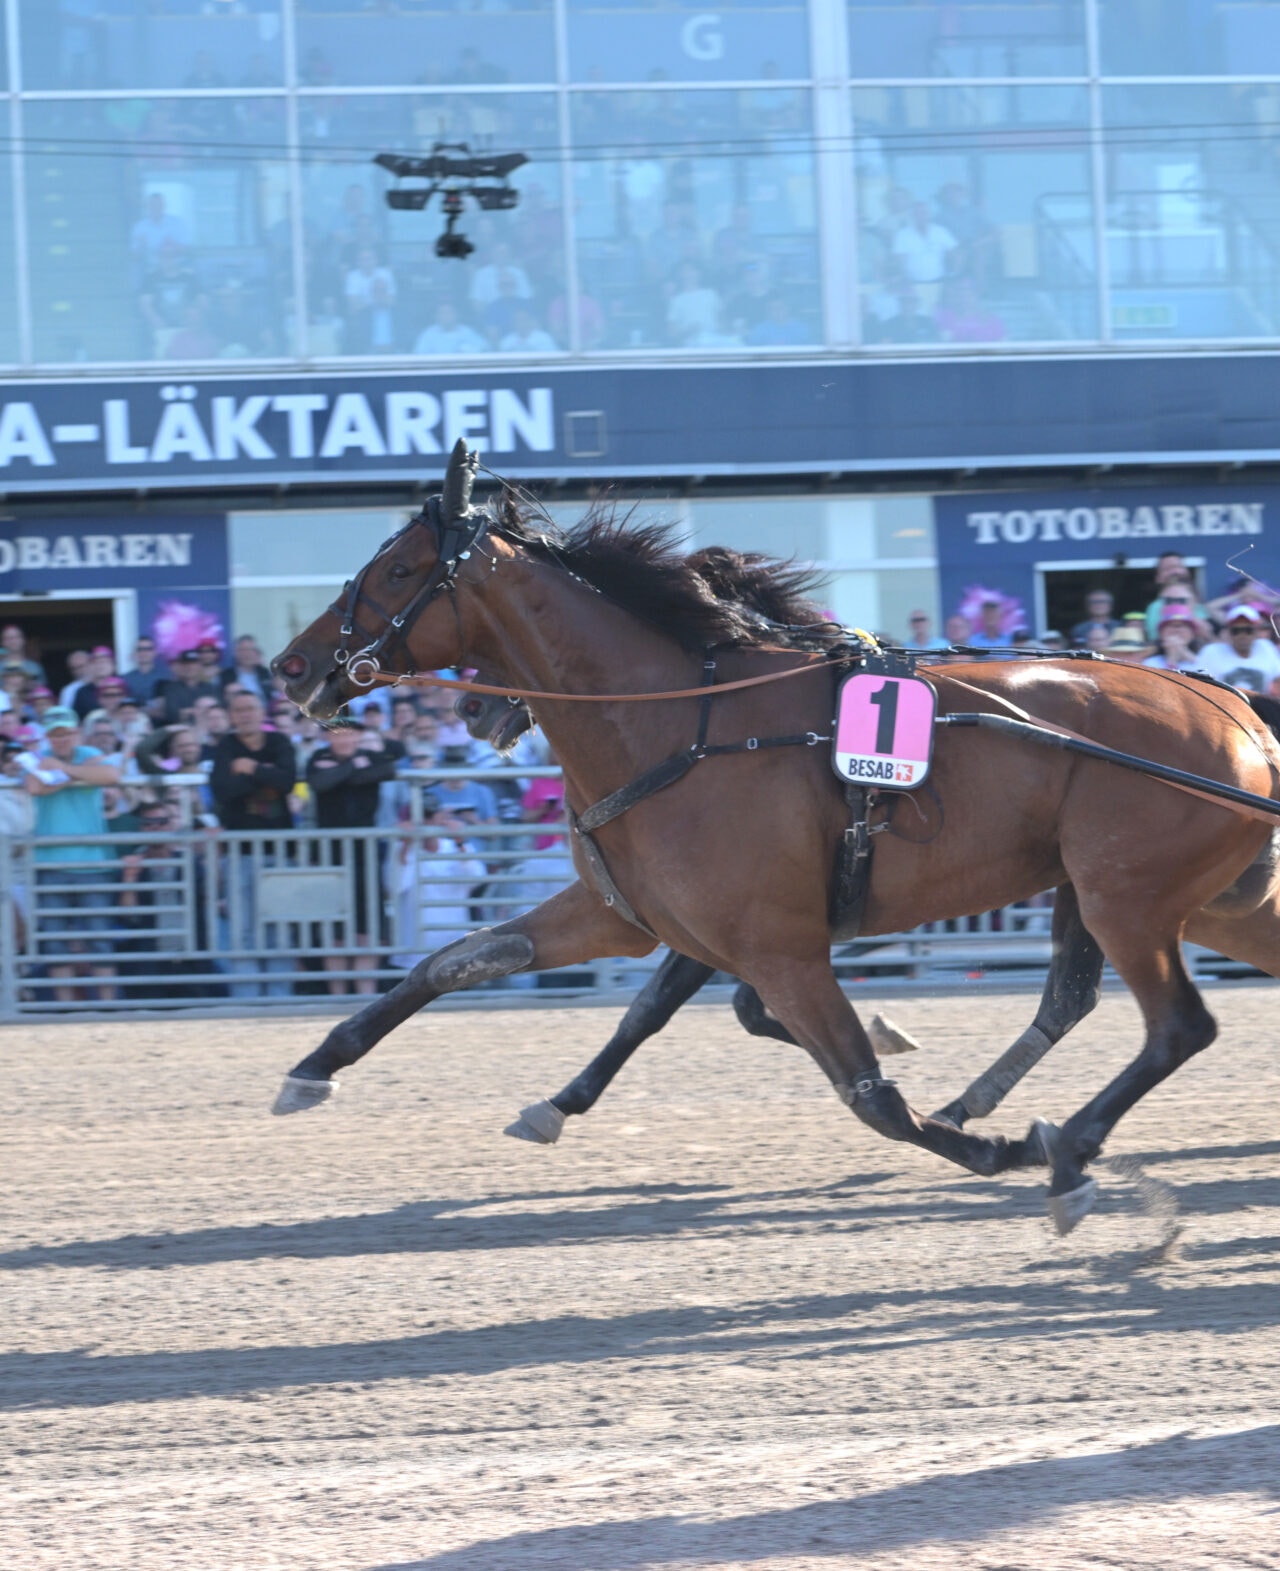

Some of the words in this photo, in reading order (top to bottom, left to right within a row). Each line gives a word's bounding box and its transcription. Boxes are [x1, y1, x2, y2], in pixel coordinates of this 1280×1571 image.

[681, 14, 725, 60] G
[0, 384, 556, 467] A-LÄKTAREN
[966, 503, 1265, 544] TOTOBAREN
[870, 680, 899, 755] 1
[848, 758, 893, 780] BESAB
